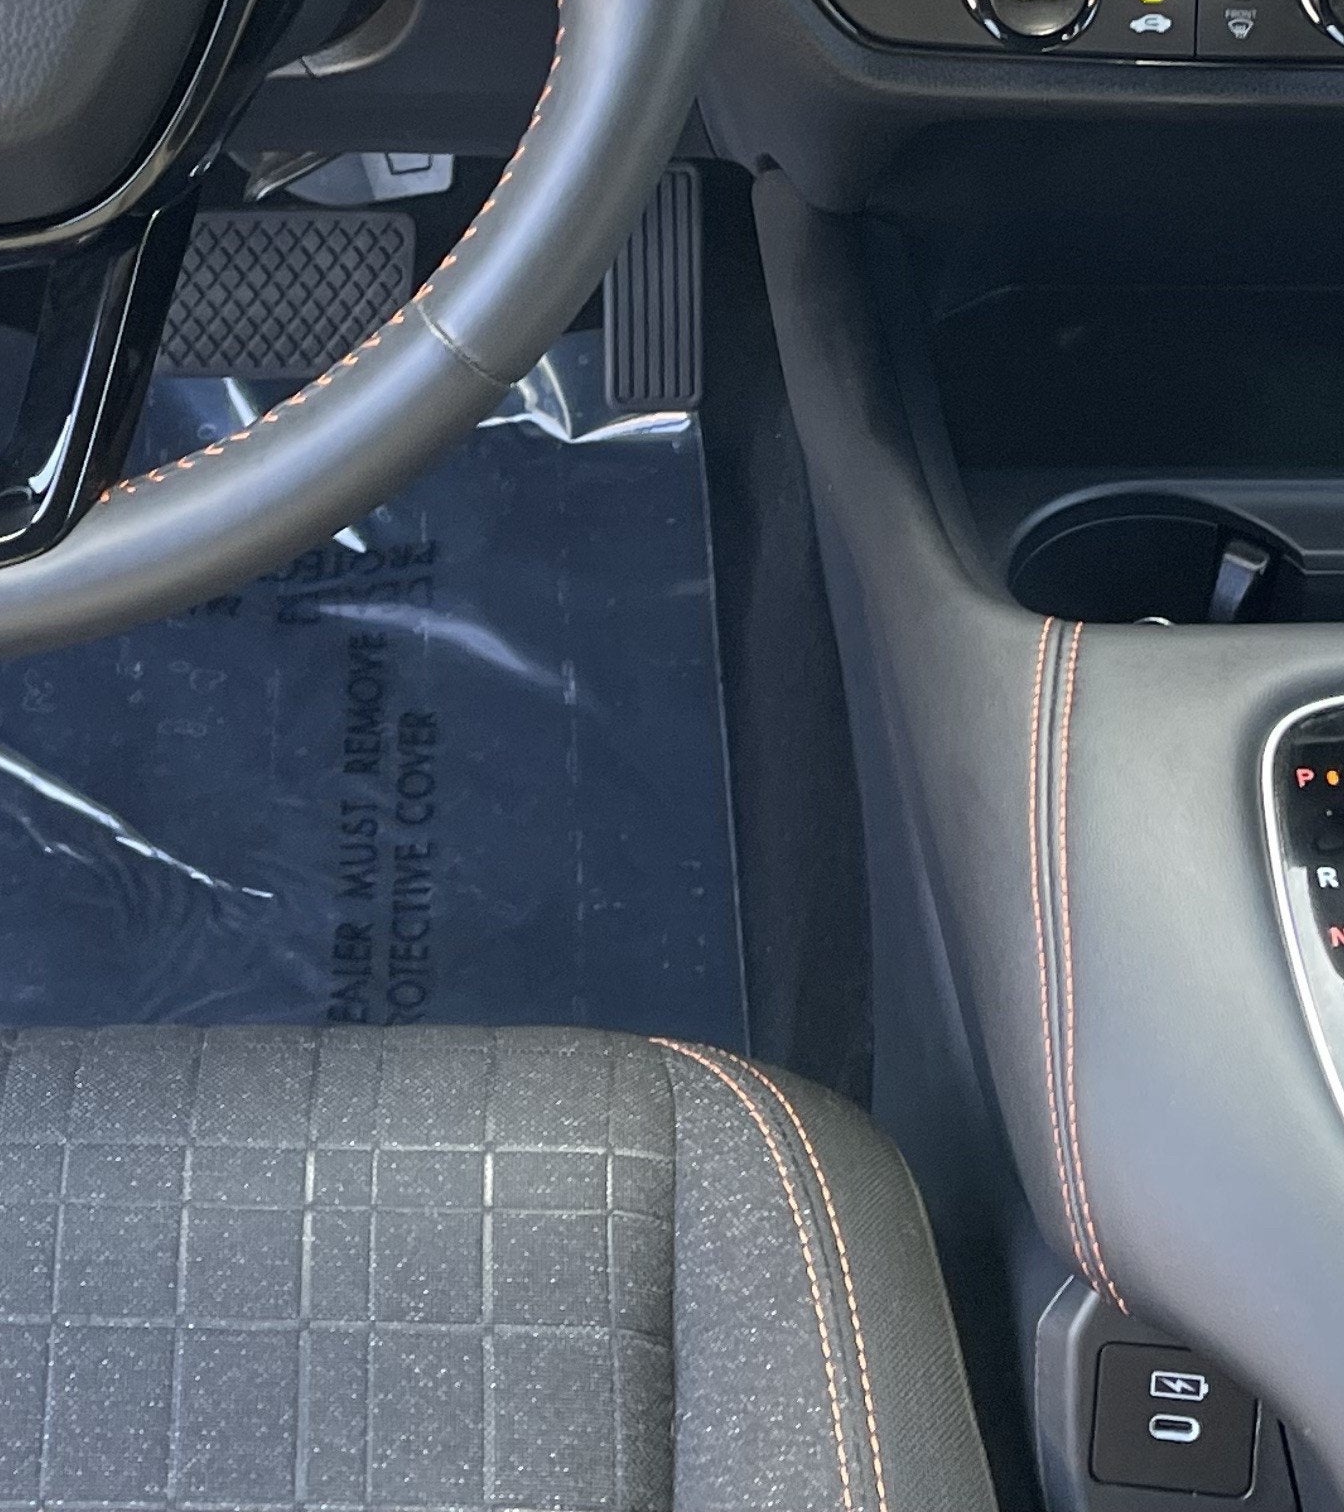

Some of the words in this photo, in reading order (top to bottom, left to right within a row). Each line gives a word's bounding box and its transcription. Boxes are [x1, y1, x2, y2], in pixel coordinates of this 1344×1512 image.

[395, 711, 439, 826] COVER
[1295, 768, 1314, 788] P
[1317, 866, 1339, 888] R
